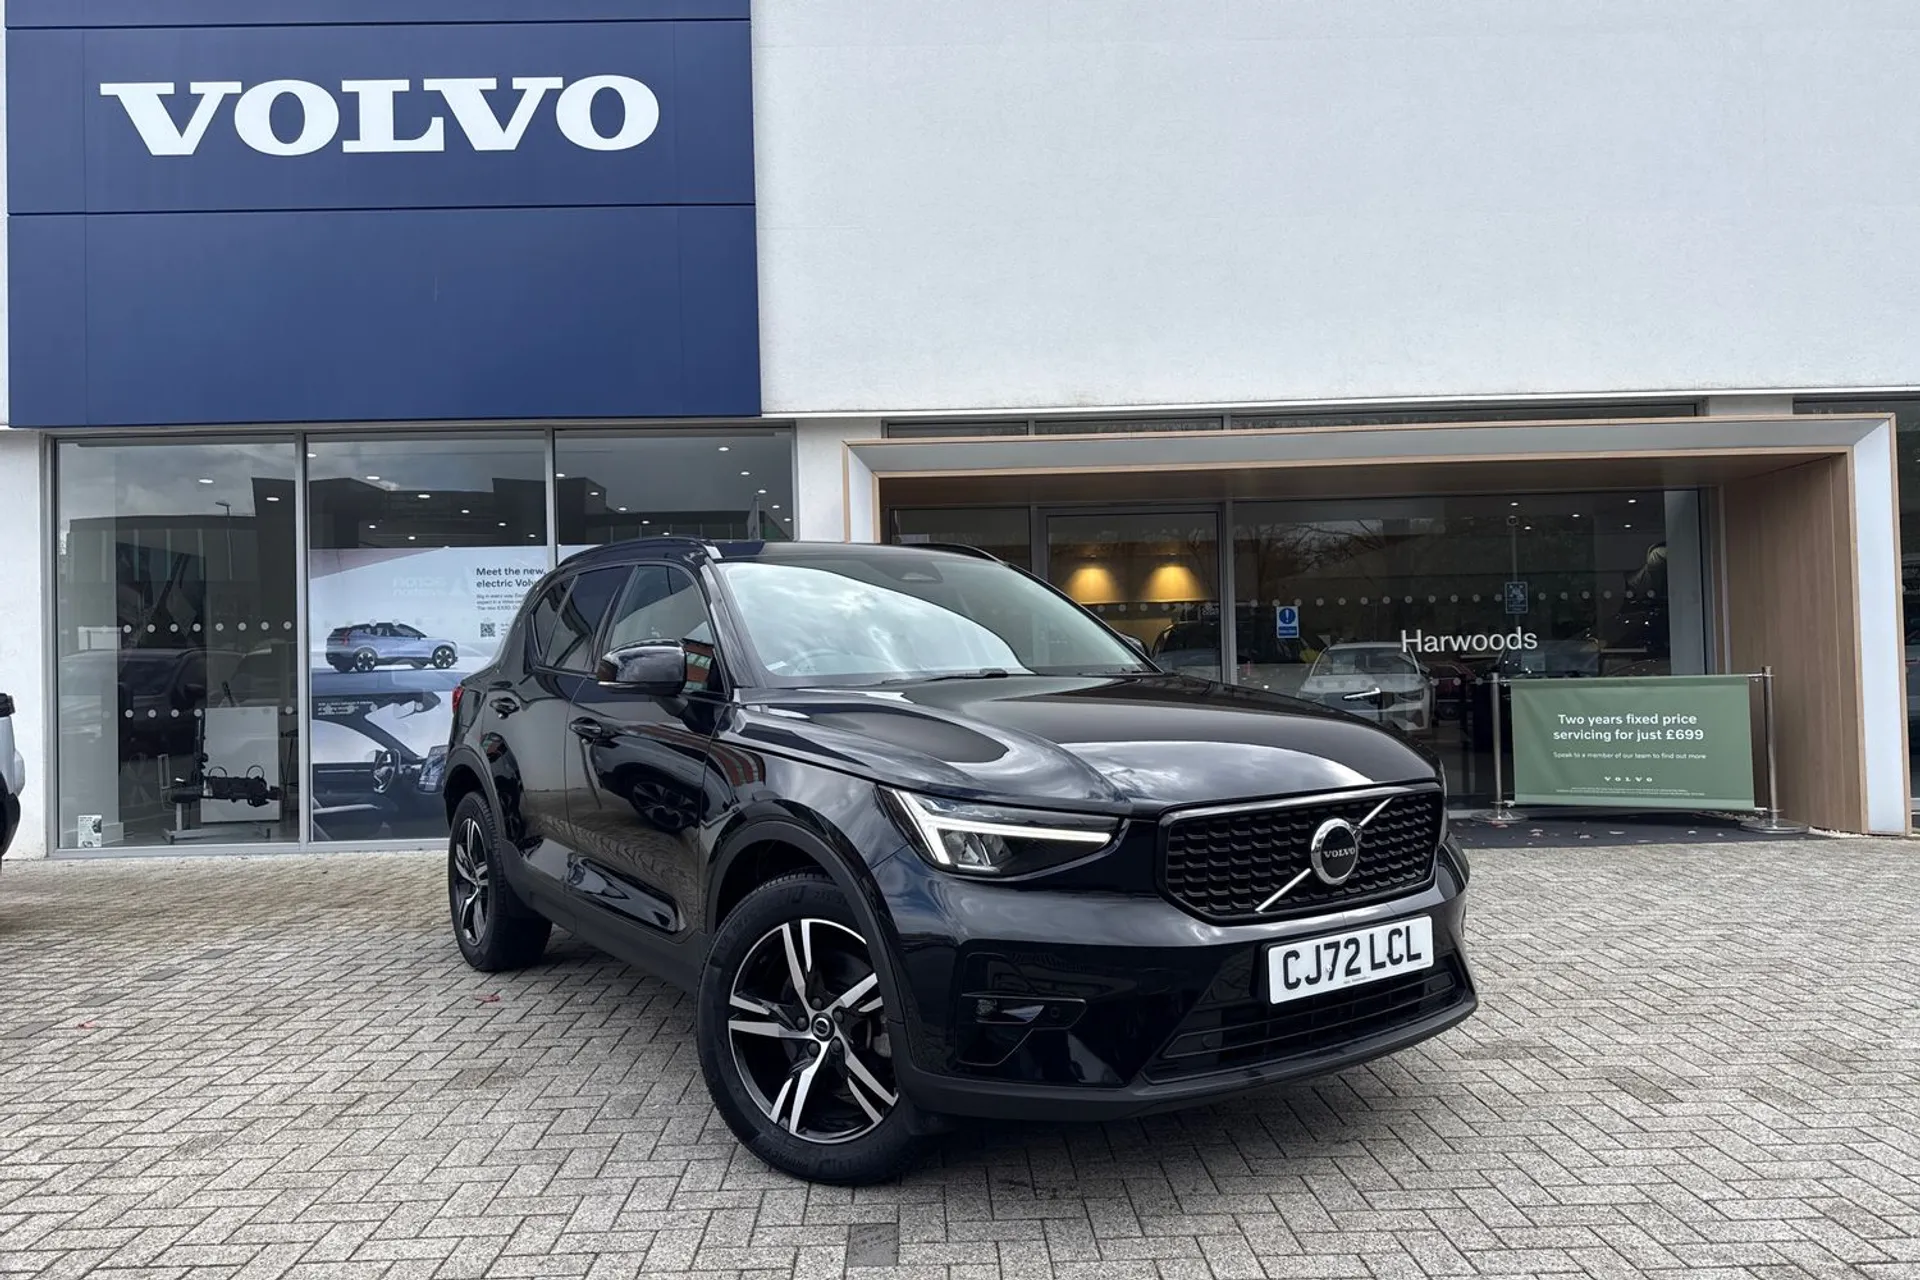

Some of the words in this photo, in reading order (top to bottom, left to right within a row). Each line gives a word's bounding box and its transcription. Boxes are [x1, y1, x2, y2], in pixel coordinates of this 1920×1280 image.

[100, 75, 660, 156] VOLVO
[476, 568, 502, 576] Meet
[504, 567, 520, 576] the
[476, 580, 513, 588] electric
[515, 579, 536, 588] Volv
[1401, 626, 1538, 653] Harwoods
[1557, 714, 1585, 725] Two
[1588, 716, 1623, 726] years
[1626, 713, 1659, 725] fixed
[1662, 713, 1698, 726] price
[1553, 729, 1611, 742] servicing
[1615, 729, 1634, 740] for
[1636, 729, 1662, 742] just
[1666, 729, 1704, 740] £699
[1553, 751, 1573, 759] Speak
[1323, 847, 1356, 858] VOLVO
[1282, 937, 1362, 990] CJ72
[1369, 926, 1422, 971] LCL
